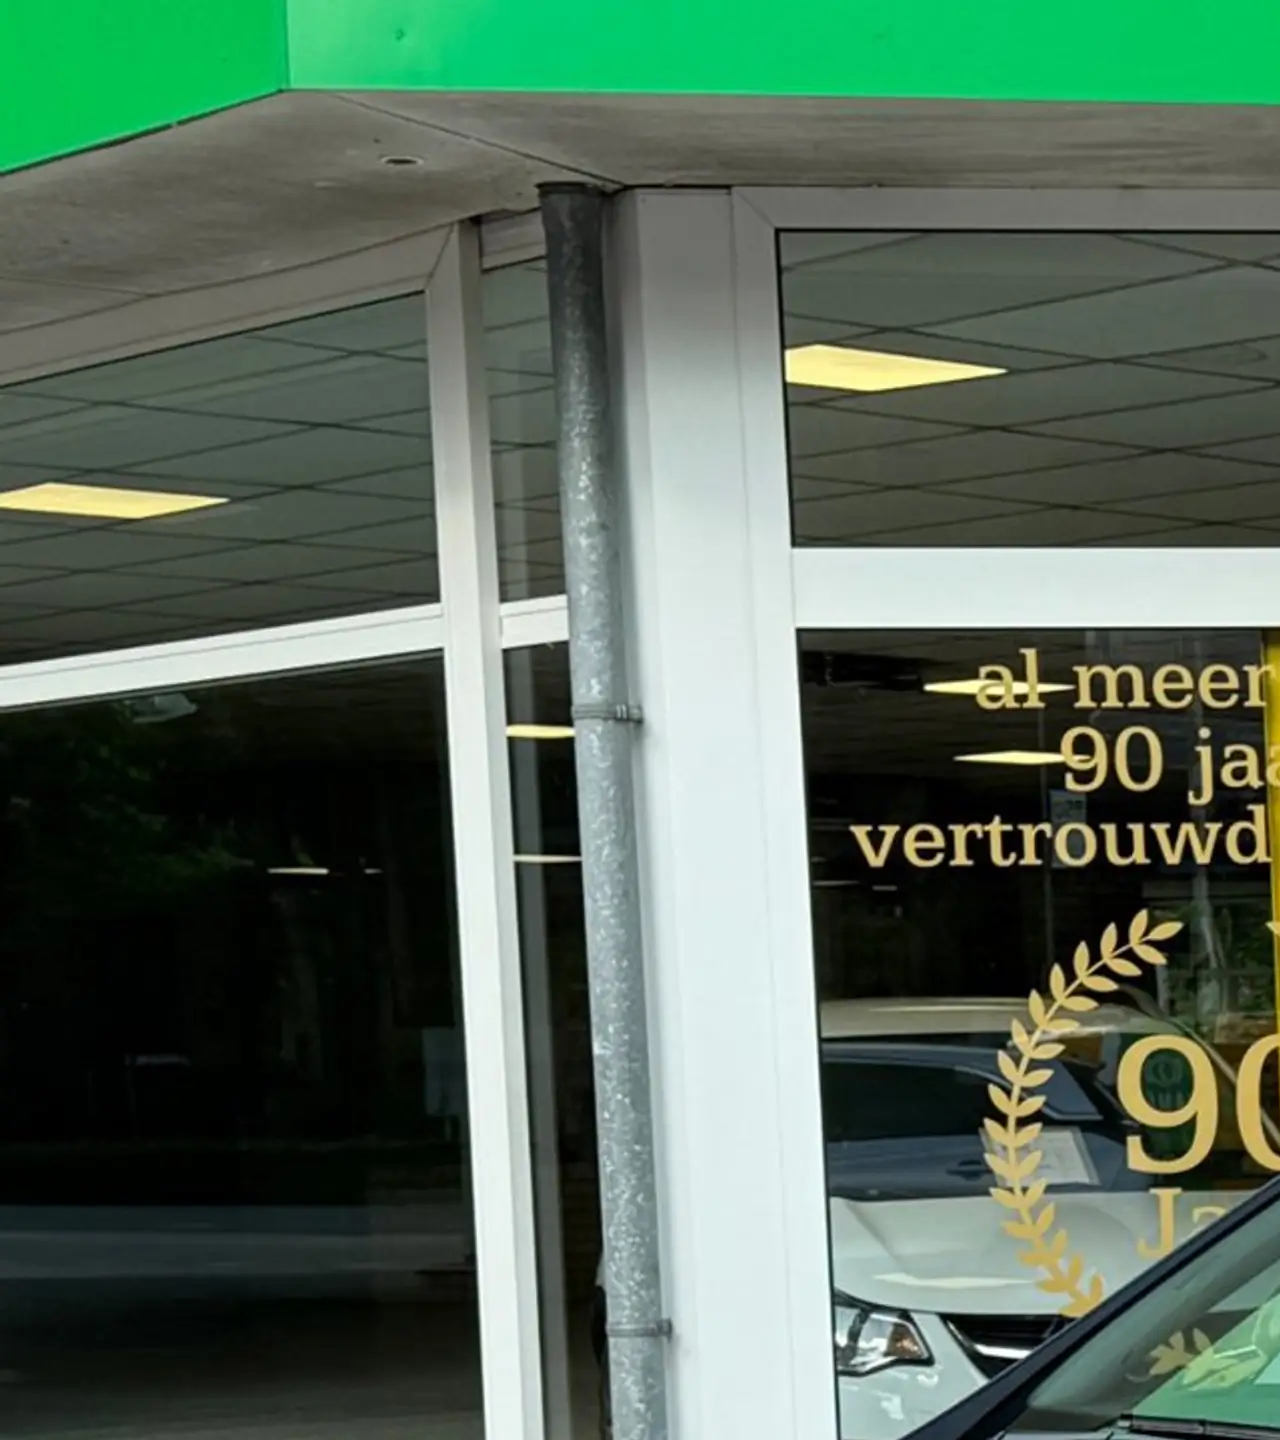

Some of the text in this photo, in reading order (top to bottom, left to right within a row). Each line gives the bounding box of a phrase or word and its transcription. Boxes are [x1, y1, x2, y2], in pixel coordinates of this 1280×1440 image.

[975, 647, 1046, 710] al
[1072, 660, 1272, 710] meer
[1059, 726, 1163, 793] 90
[851, 804, 1271, 868] vertrouwd
